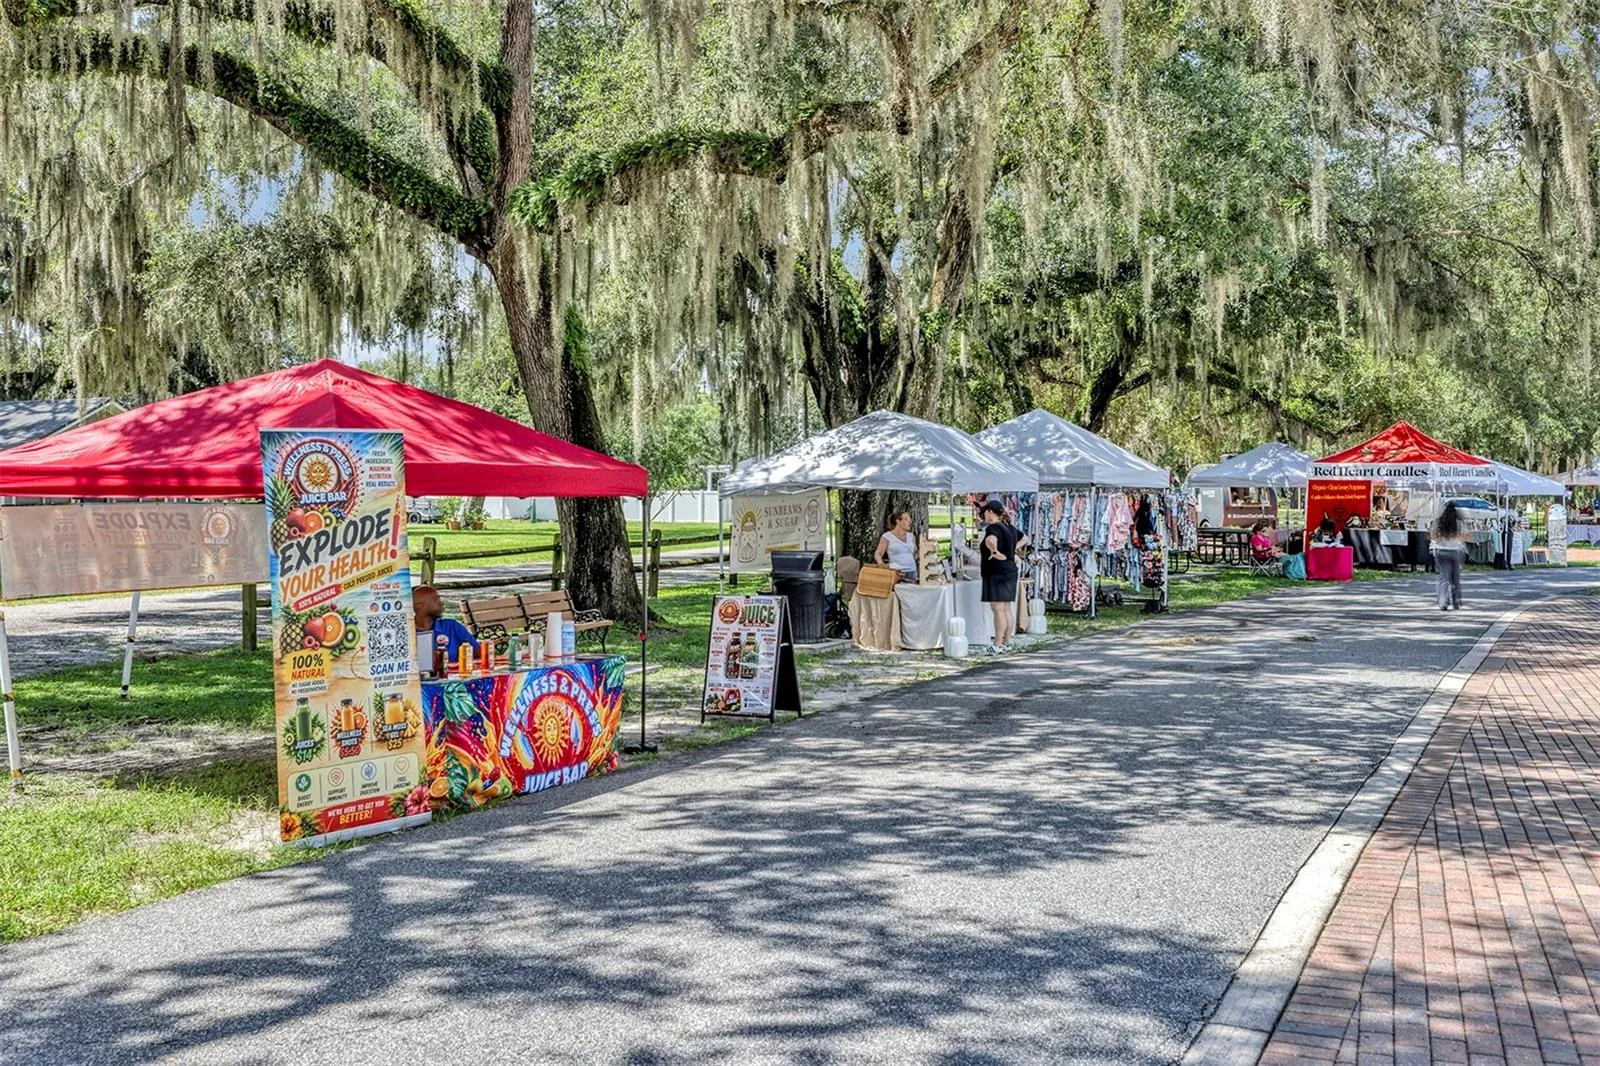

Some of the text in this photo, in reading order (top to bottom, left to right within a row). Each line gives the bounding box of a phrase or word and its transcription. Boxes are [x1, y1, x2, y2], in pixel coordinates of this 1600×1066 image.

[284, 442, 323, 476] WELLNESS
[330, 446, 352, 476] PRESS
[1314, 466, 1428, 478] Red Heart Candles
[1440, 466, 1496, 478] Red Heart Candles
[300, 492, 348, 504] JUICE BAR
[764, 504, 802, 518] SUNBEAMS
[776, 516, 798, 529] SUGAR
[280, 564, 326, 602] YOUR
[343, 566, 393, 590] COLD PRESSED JUICES
[738, 604, 776, 624] JUICE
[292, 653, 324, 670] 100%
[370, 661, 410, 676] SCAN ME
[292, 668, 325, 680] NATURAL
[500, 674, 602, 758] WELLNESS & PRESS
[295, 740, 315, 749] JUICES
[296, 750, 314, 764] $14
[520, 761, 588, 794] JUICE BAR
[327, 794, 348, 802] IMMUNITY
[328, 788, 346, 796] SUPPORT
[328, 809, 342, 817] WE'RE
[340, 810, 373, 824] BETTER!
